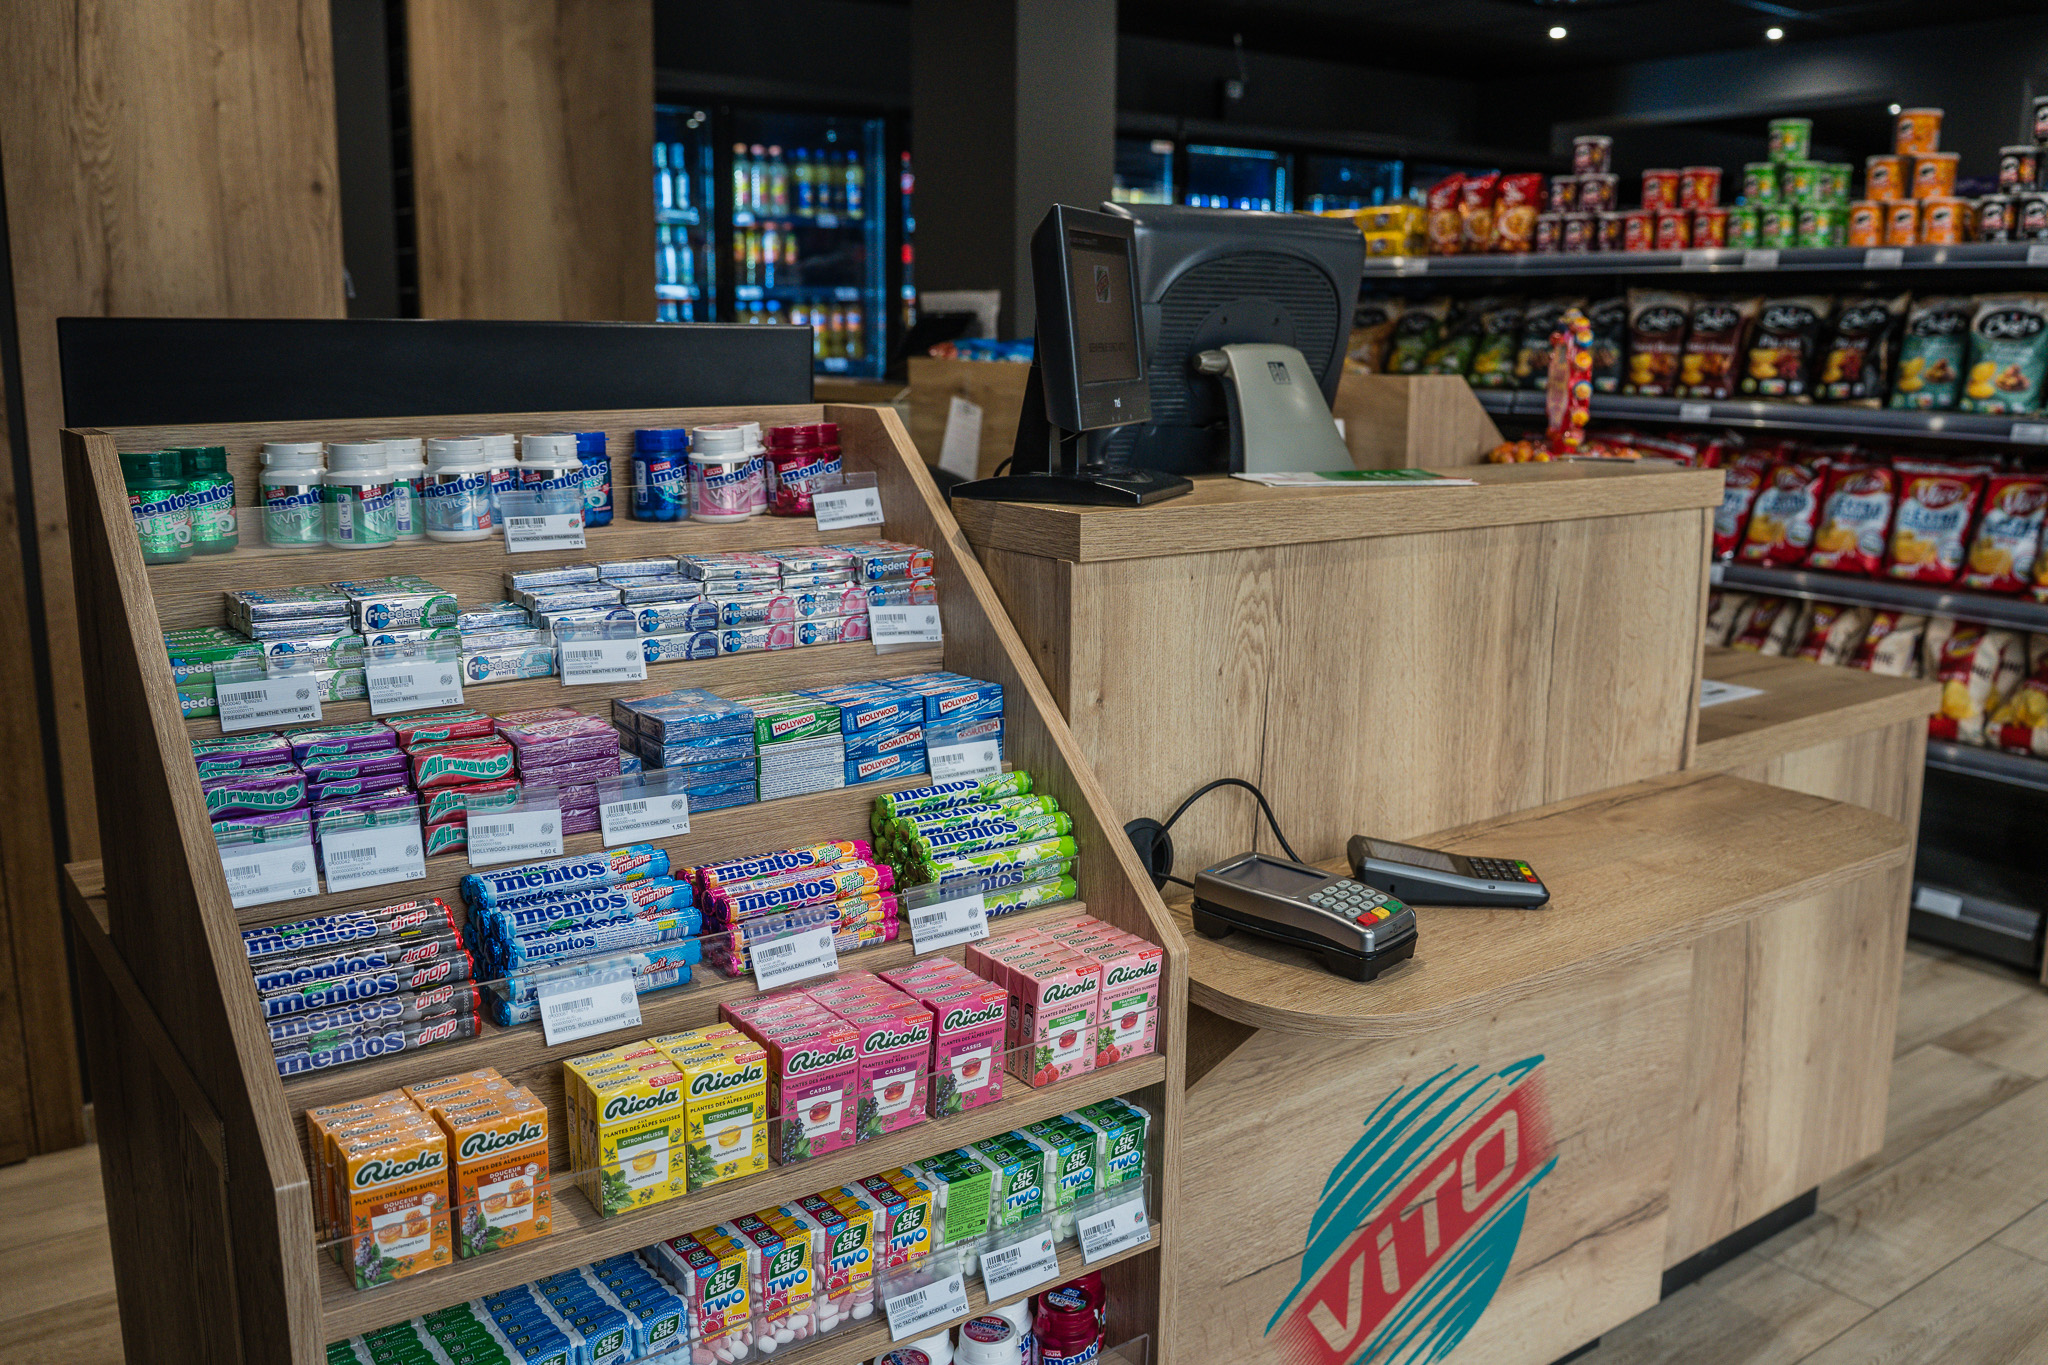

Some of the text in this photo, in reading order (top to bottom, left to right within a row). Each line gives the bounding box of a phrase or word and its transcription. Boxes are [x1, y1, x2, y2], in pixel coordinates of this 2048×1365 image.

[425, 474, 486, 499] mentos
[867, 560, 910, 575] Freedent
[366, 604, 425, 625] Freedent
[639, 611, 689, 627] Freedent
[723, 608, 769, 622] Freedent
[723, 632, 769, 647] Freedent
[799, 626, 843, 641] Freedent
[642, 641, 689, 655] Freedent
[468, 657, 522, 677] Freedent
[941, 693, 979, 712] HOLLYWOOD
[223, 713, 253, 721] FREEDENT
[256, 709, 279, 717] MENTHE
[774, 714, 815, 734] HOLLYWOOD
[859, 706, 899, 724] HOLLYWOOD
[879, 731, 922, 751] HOLLYWOOD
[319, 767, 359, 781] Airwaves
[420, 752, 509, 780] Airwaves
[861, 755, 899, 774] HOLLYWOOD
[205, 779, 300, 810] Airwaves
[893, 778, 980, 803] mentos
[609, 824, 641, 833] HOLLYWOOD
[650, 818, 670, 826] CHLORO
[928, 820, 1019, 848] mentos
[473, 846, 506, 854] HOLLYWOOD
[528, 841, 551, 849] CHLORO
[617, 853, 652, 874] menthe
[715, 850, 815, 883] mentos
[332, 867, 400, 881] AIRWAVES COOL CERISE
[495, 859, 607, 893] mentos
[292, 888, 307, 896] 1,50
[639, 884, 675, 907] menthe
[738, 878, 837, 914] mentos
[514, 891, 630, 926] mentos
[390, 909, 428, 931] drop
[245, 918, 378, 957] mentos
[915, 934, 935, 943] MENTOS
[954, 926, 969, 934] POMME
[526, 934, 596, 958] mentos
[257, 953, 388, 990] mentos
[411, 961, 450, 987] drop
[761, 957, 821, 979] MENTOS ROULEAU FRUITS
[1107, 961, 1158, 986] Ricola
[267, 972, 400, 1017] mentos
[416, 984, 454, 1010] drop
[1043, 977, 1097, 1004] Ricola
[270, 997, 404, 1041] mentos
[553, 1013, 626, 1035] MENTOS ROULEAU MENTHE
[623, 1019, 636, 1027] 1,50
[942, 1003, 1004, 1031] Ricola
[418, 1018, 457, 1045] drop
[864, 1025, 928, 1053] Ricola
[276, 1030, 406, 1077] mentos
[961, 1042, 982, 1052] CASSIS
[787, 1044, 856, 1074] Ricola
[690, 1064, 763, 1095] Ricola
[884, 1066, 906, 1076] CASSIS
[809, 1085, 832, 1095] CASSIS
[604, 1086, 679, 1121] Ricola
[690, 1090, 764, 1113] PLANTES DES ALPES SUISSES
[708, 1106, 748, 1121] CITRON MÉLISSE
[604, 1129, 628, 1139] PLANTES
[641, 1121, 658, 1130] ALPES
[659, 1114, 681, 1124] SUISSES
[462, 1122, 542, 1157] Ricola
[622, 1129, 664, 1146] CITRON MÉLISSE
[1118, 1133, 1135, 1146] tic
[1070, 1149, 1088, 1163] tic
[1113, 1142, 1134, 1155] tac
[355, 1151, 442, 1185] Ricola
[463, 1150, 546, 1176] PLANTES DES ALPES SUISSES
[1066, 1159, 1087, 1172] tac
[1108, 1151, 1141, 1173] TWO
[490, 1166, 522, 1179] DOUCEUR
[1016, 1168, 1034, 1182] tic
[1060, 1167, 1094, 1190] TWO
[355, 1179, 445, 1206] PLANTES DES ALPES SUISSES
[1011, 1178, 1034, 1192] tac
[384, 1196, 418, 1209] DOUCEUR
[1006, 1187, 1041, 1210] TWO
[902, 1209, 921, 1221] tic
[842, 1229, 862, 1241] tic
[897, 1219, 920, 1233] tac
[836, 1238, 861, 1253] tac
[890, 1228, 928, 1252] TWO
[1114, 1234, 1129, 1244] CHLORO
[779, 1249, 800, 1261] tic
[830, 1248, 869, 1273] TWO
[715, 1269, 736, 1282] tic
[774, 1259, 799, 1275] tac
[1017, 1268, 1031, 1276] FRAMB
[1032, 1261, 1047, 1269] CITRON
[709, 1279, 735, 1296] tac
[767, 1269, 808, 1295] TWO
[702, 1289, 745, 1316] TWO
[657, 1319, 675, 1330] tic
[894, 1304, 947, 1330] TIC TAC POMME ACIDULE
[653, 1327, 675, 1340] tac
